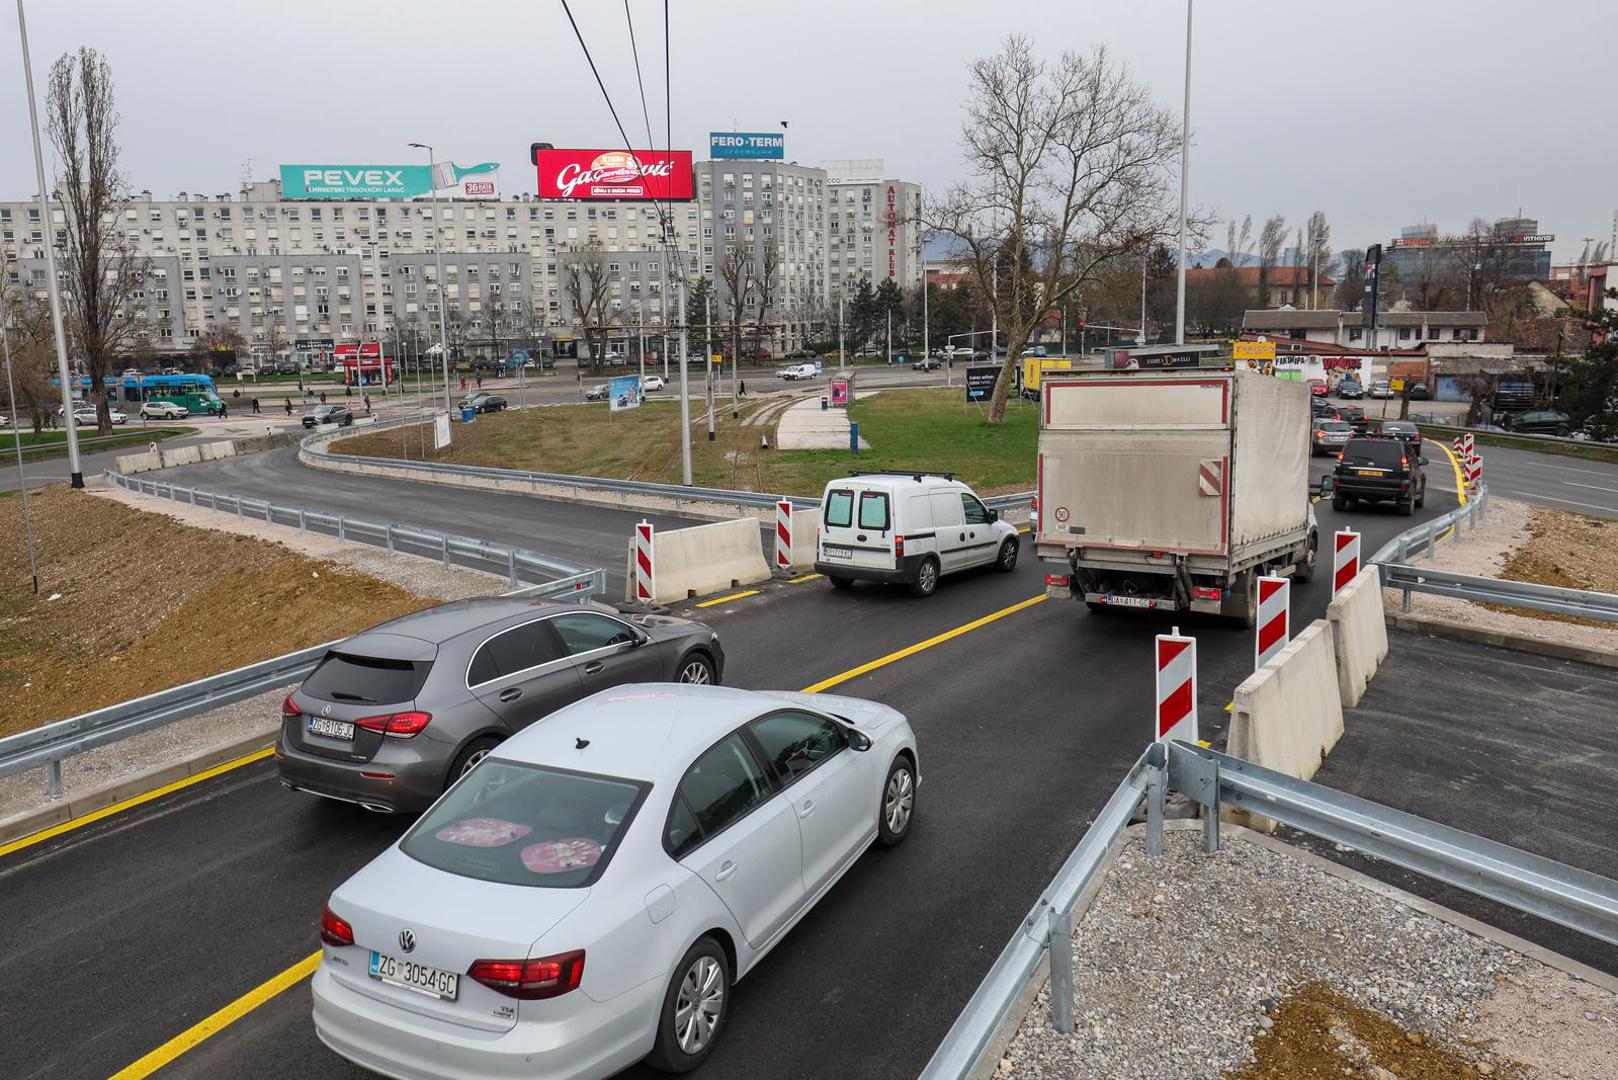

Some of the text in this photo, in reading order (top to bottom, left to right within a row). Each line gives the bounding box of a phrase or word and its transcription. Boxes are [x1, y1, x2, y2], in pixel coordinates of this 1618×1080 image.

[303, 170, 404, 186] PEVEX
[465, 182, 479, 193] 36
[556, 160, 675, 197] Gavić
[887, 185, 896, 276] AUTOMAT KLUB
[380, 955, 396, 976] ZG
